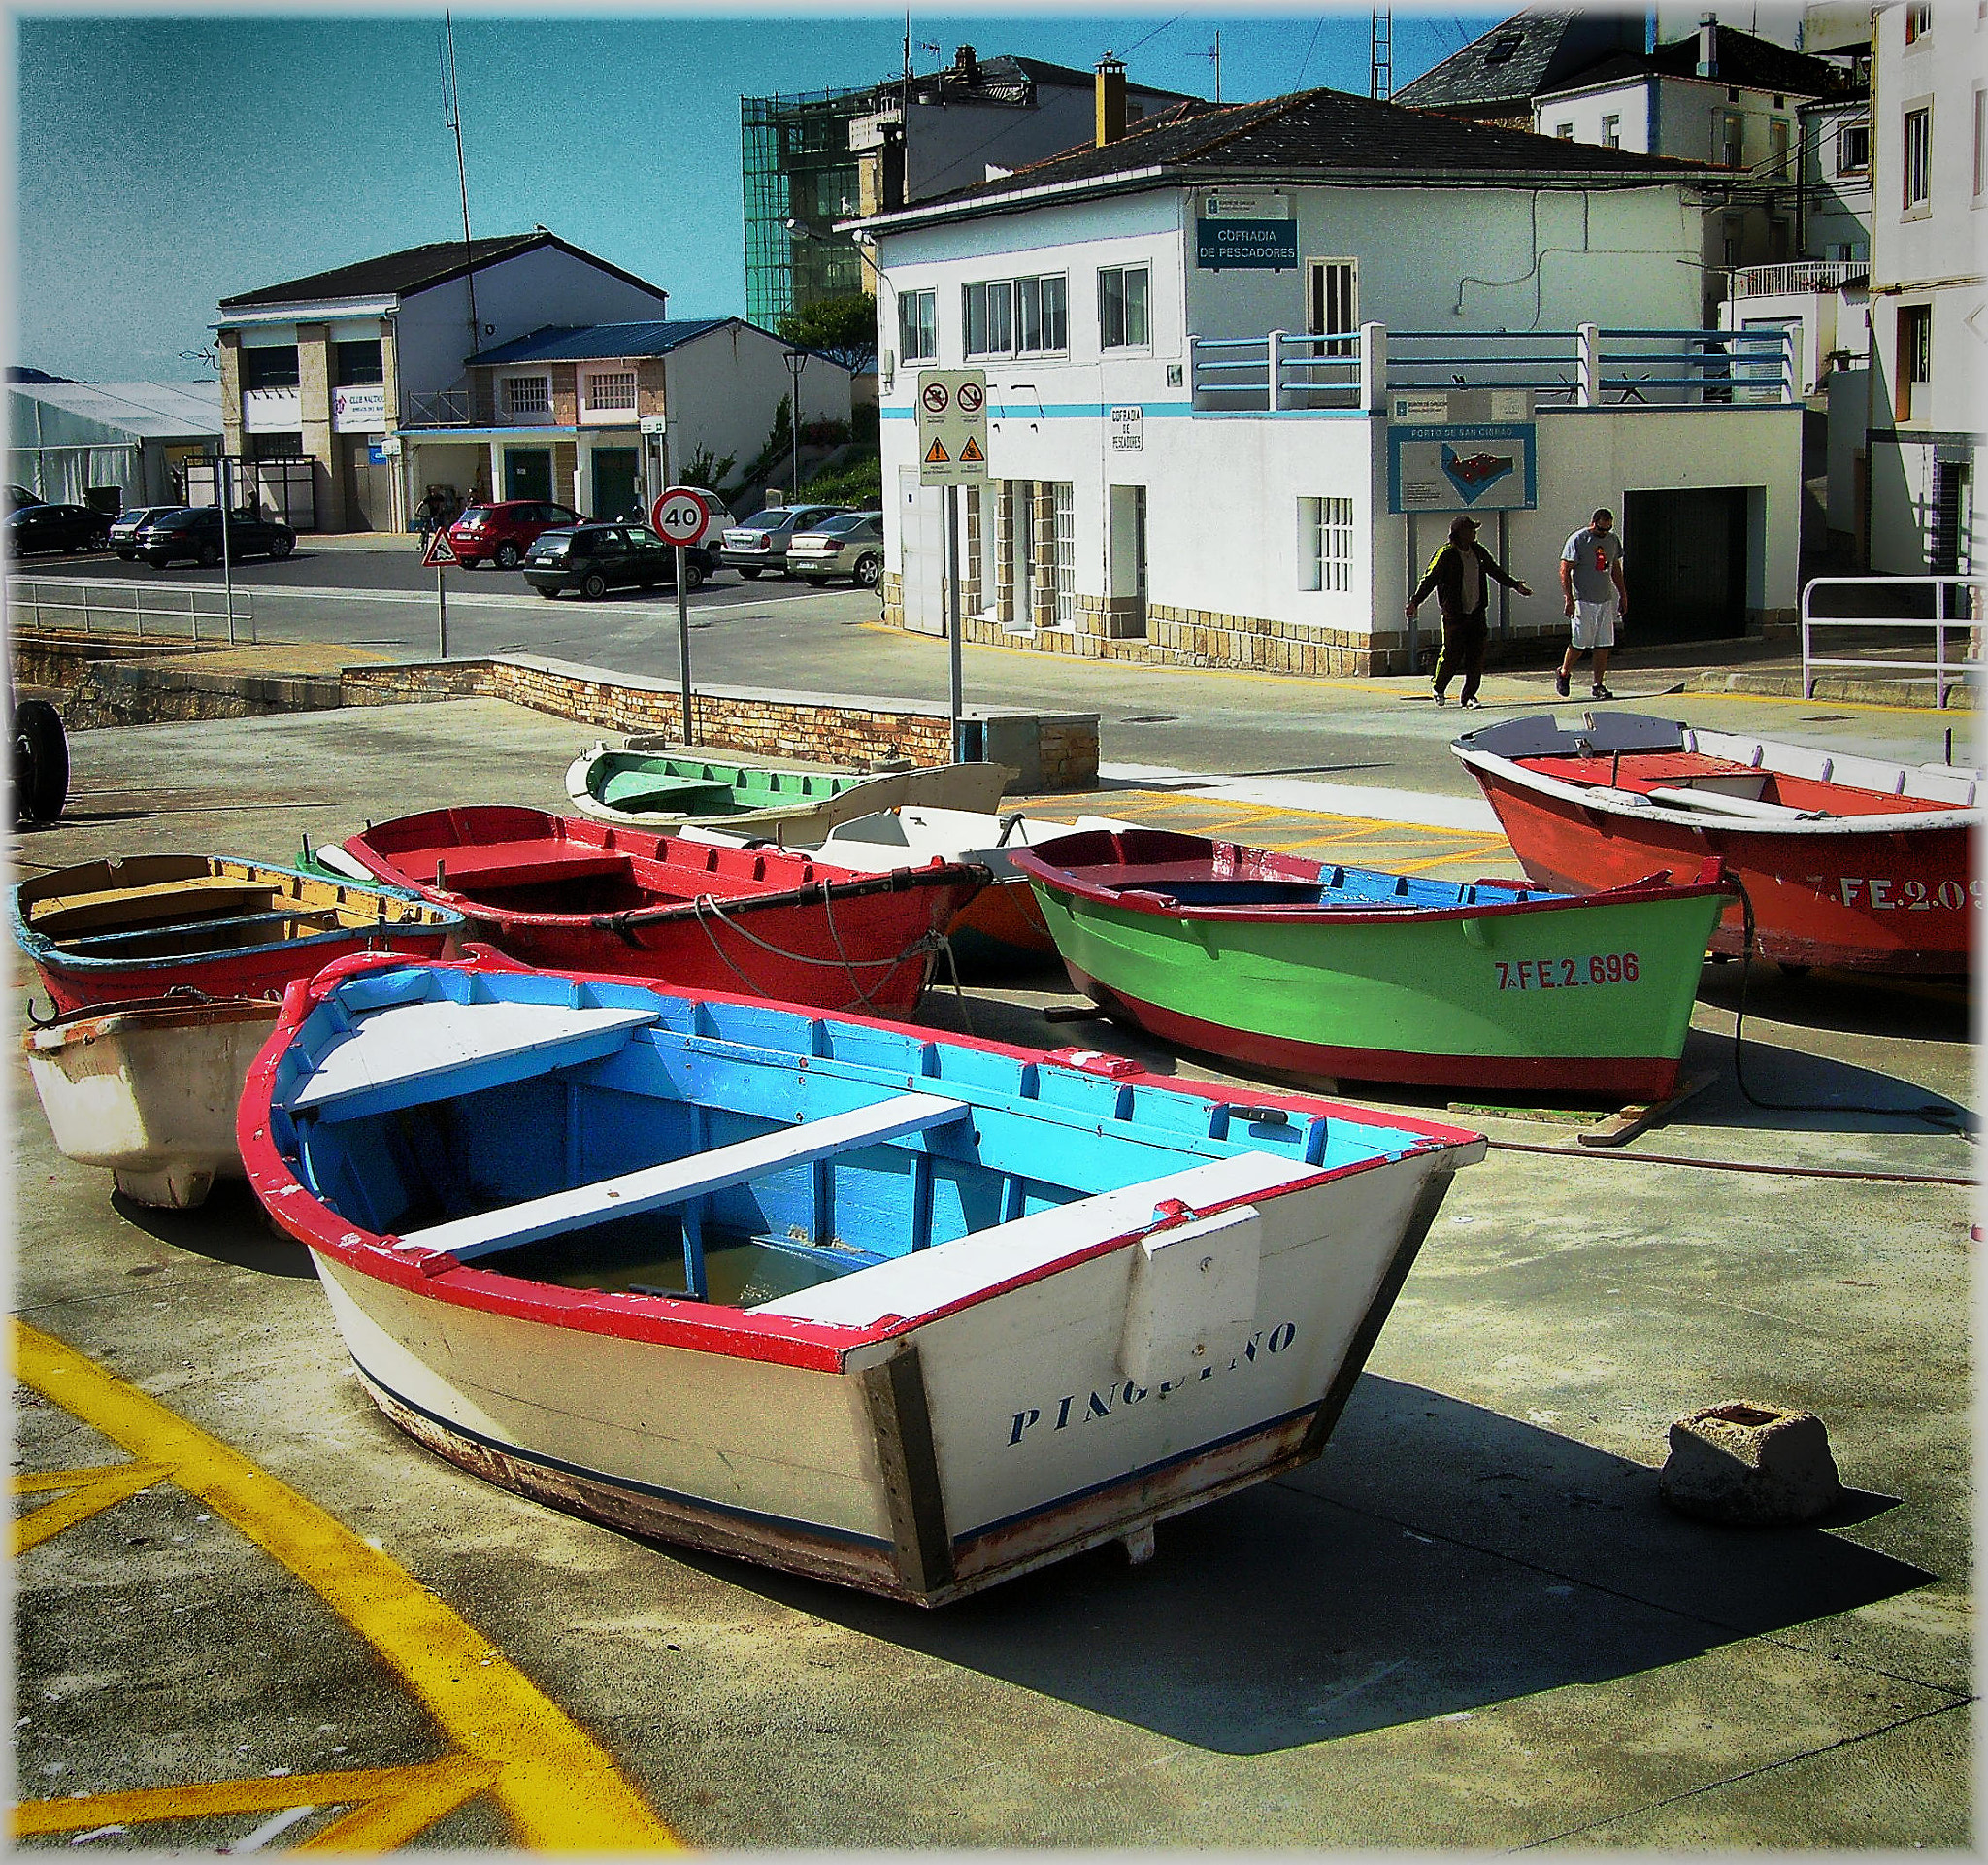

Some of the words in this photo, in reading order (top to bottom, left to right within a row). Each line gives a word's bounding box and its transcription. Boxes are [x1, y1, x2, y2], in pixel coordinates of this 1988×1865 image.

[1200, 248, 1215, 258] DE
[1219, 247, 1295, 258] PESCADORES
[1122, 423, 1131, 434] DE
[665, 509, 698, 527] 40
